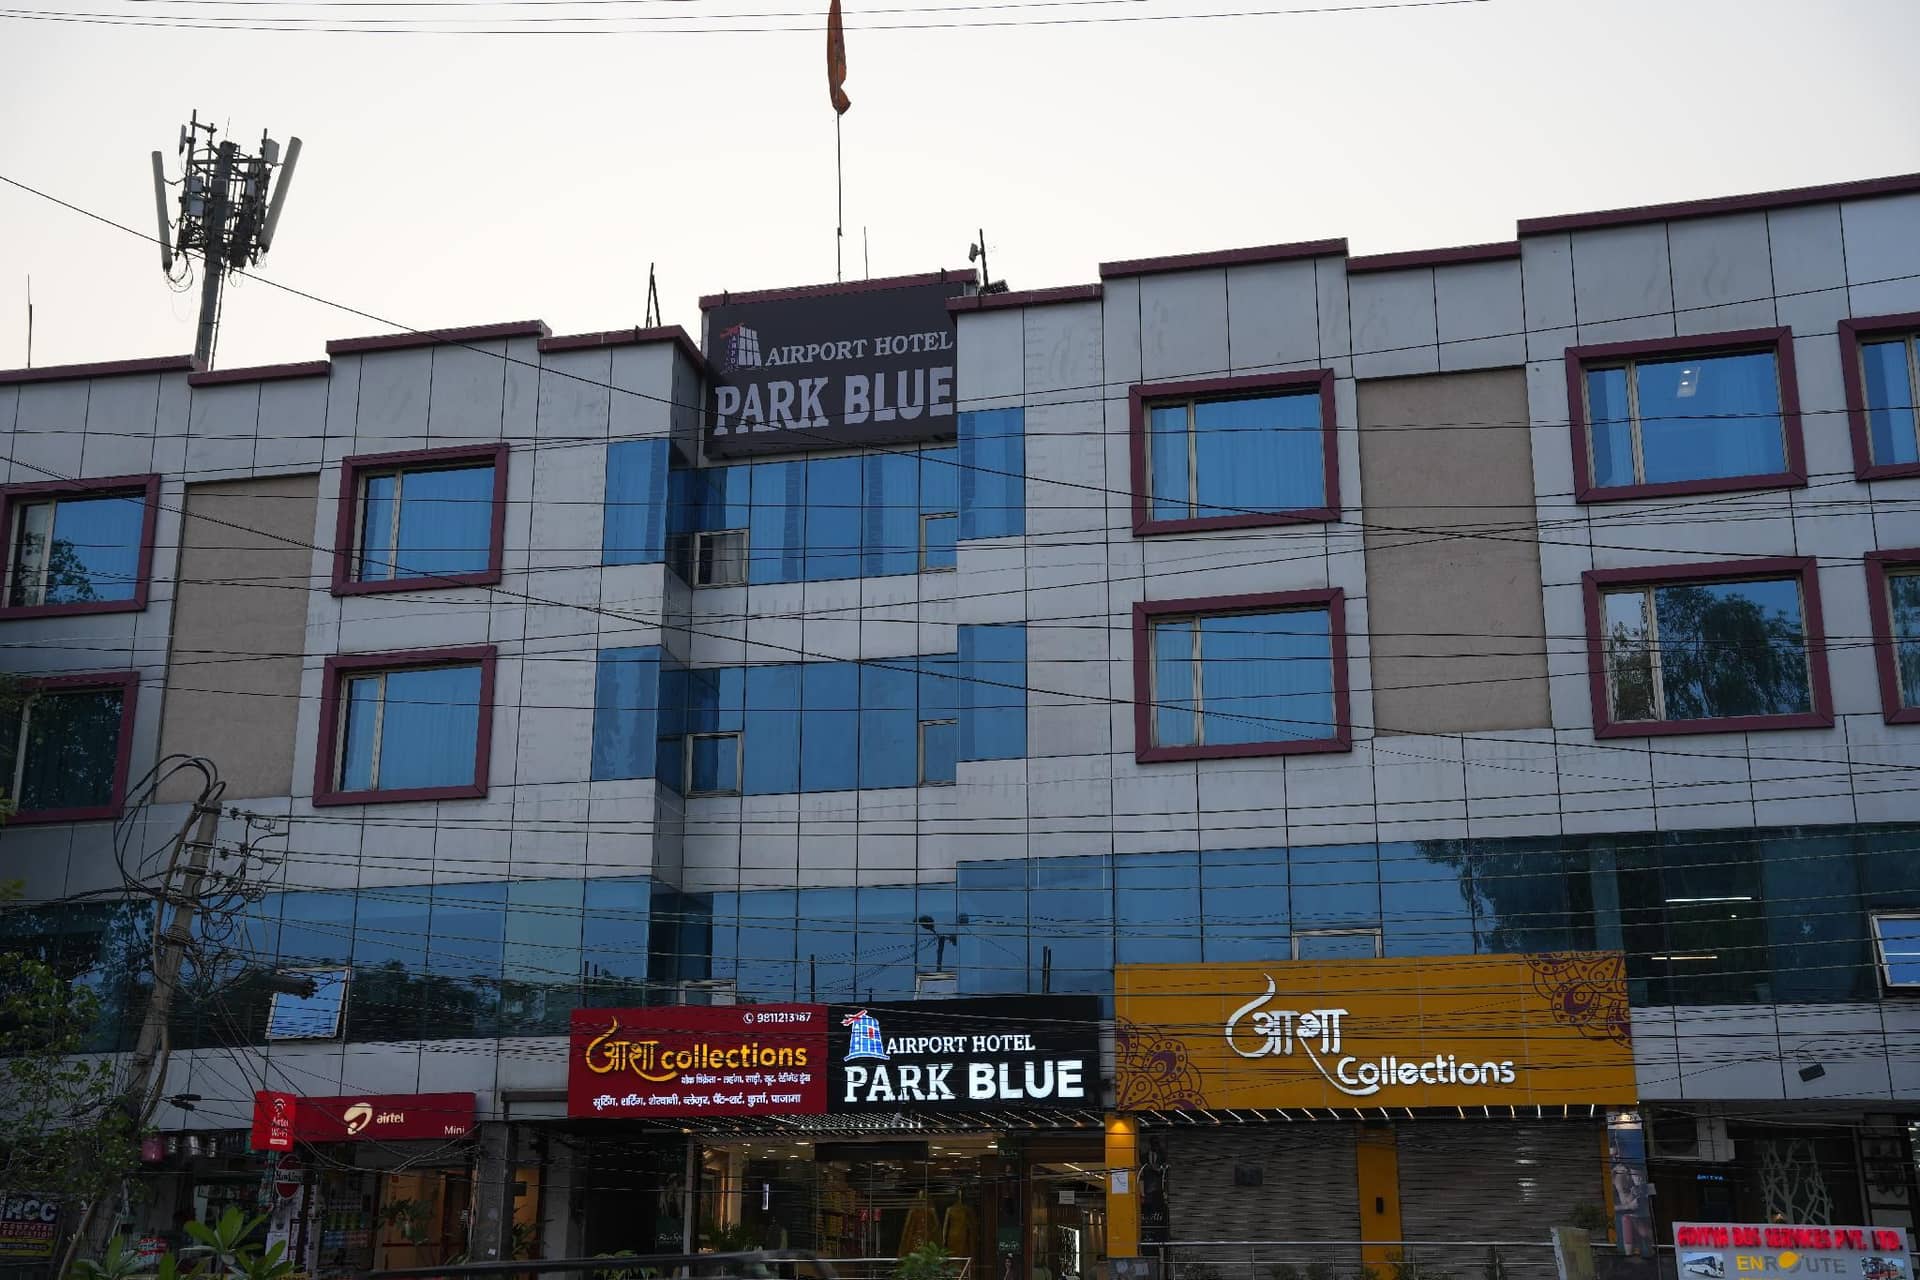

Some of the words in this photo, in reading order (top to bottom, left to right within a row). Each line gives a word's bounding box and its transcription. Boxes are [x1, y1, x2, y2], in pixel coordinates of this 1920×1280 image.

[765, 339, 868, 366] AIRPORT
[874, 331, 953, 356] HOTEL
[713, 376, 830, 436] PARK
[844, 366, 953, 424] BLUE
[661, 1042, 808, 1071] collections
[886, 1036, 967, 1054] AIRPORT
[973, 1035, 1035, 1052] HOTEL
[844, 1063, 956, 1102] PARK
[969, 1059, 1084, 1099] BLUE
[1337, 1054, 1515, 1086] Collections
[376, 1112, 404, 1124] airtel
[444, 1125, 465, 1135] Mini
